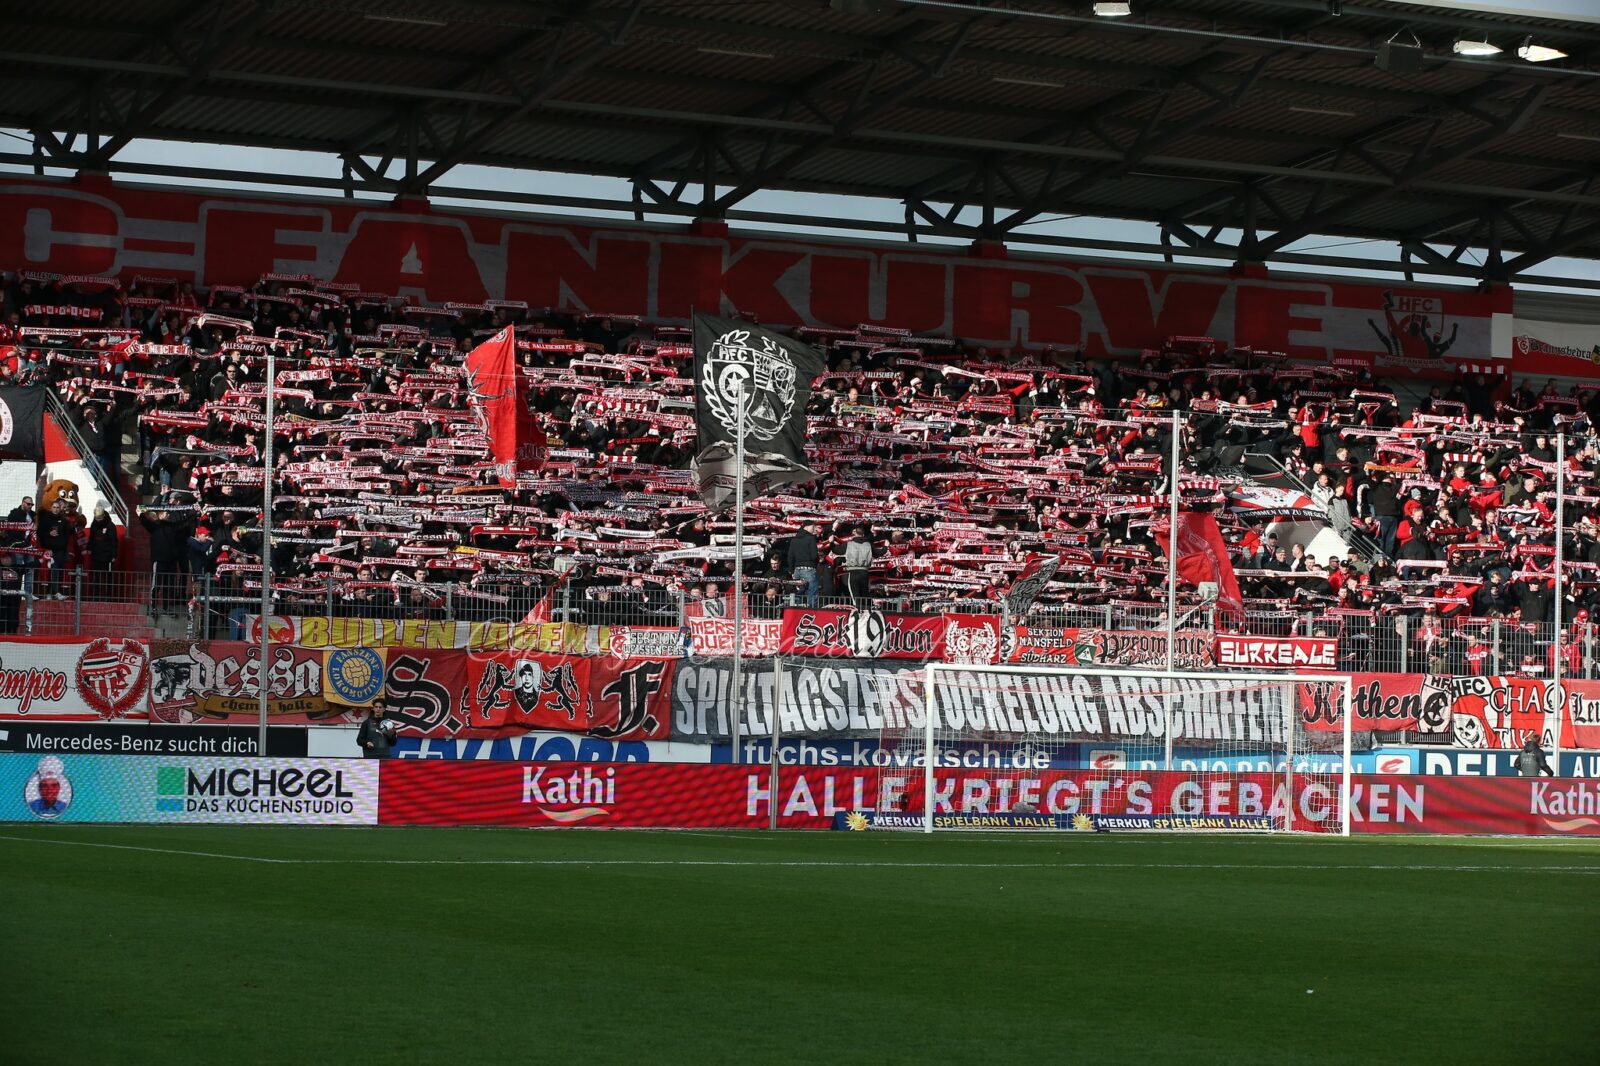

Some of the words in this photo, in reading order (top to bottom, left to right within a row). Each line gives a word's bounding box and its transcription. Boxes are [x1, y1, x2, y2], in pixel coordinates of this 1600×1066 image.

[1399, 297, 1433, 312] HFC
[719, 346, 749, 362] HFC
[1237, 509, 1277, 519] EKOMMEN
[301, 616, 455, 650] BULLEN
[630, 631, 678, 645] SEKTION
[1027, 628, 1064, 637] SEKTION
[1019, 636, 1073, 648] MANSFELD
[1100, 632, 1206, 662] Pyromnie
[1020, 650, 1067, 664] SÜDHARZ
[1220, 640, 1337, 666] SURREALE
[1452, 678, 1487, 699] HFC
[26, 732, 163, 753] Mercedes-Benz
[168, 737, 216, 754] sucht
[221, 735, 258, 754] dich
[744, 738, 1051, 770] fuchs-kovatsch.de
[522, 766, 616, 804] Kathi
[187, 799, 219, 813] DAS
[226, 796, 354, 815] KÜCHENSTUDIO
[746, 774, 907, 818] HALLE
[931, 776, 1153, 818] KRIEGT'S
[1171, 779, 1425, 823] GEBACKEN
[935, 816, 1010, 828] SPIELBANK
[1014, 816, 1057, 828] HALLE
[1097, 817, 1151, 829] MERKUR
[1153, 818, 1228, 830] SPIELBANK
[1229, 818, 1270, 830] HALLE
